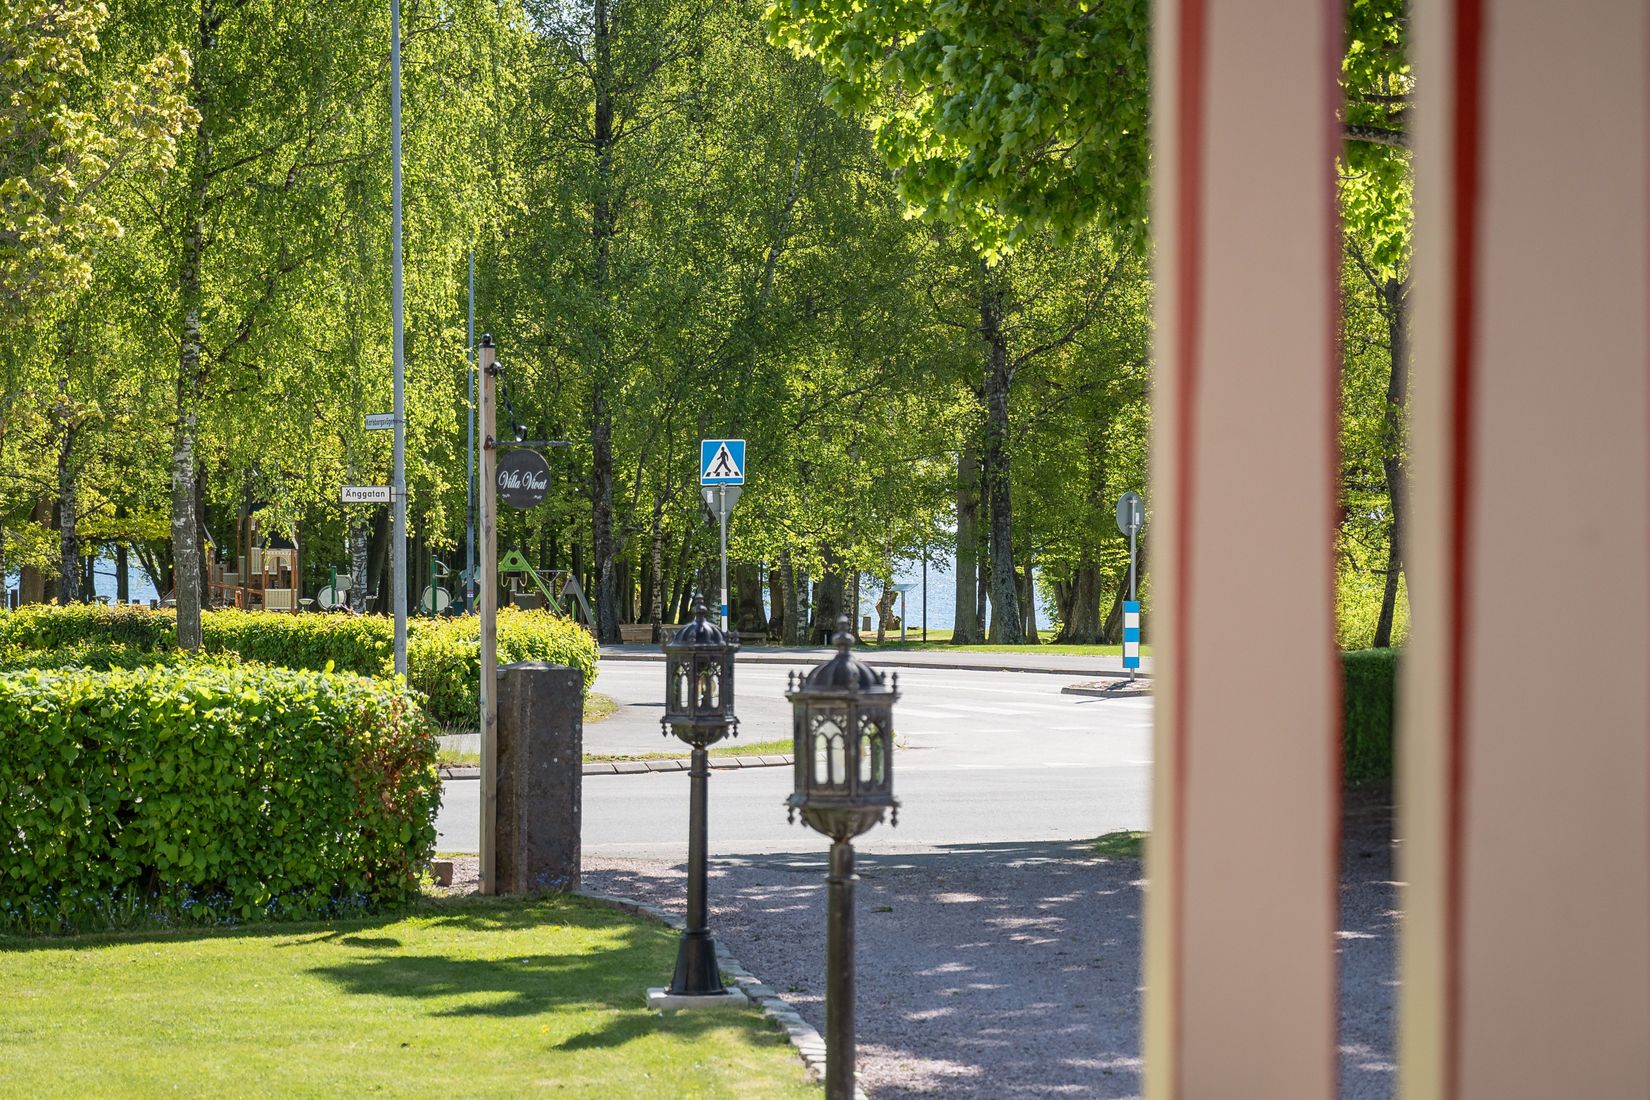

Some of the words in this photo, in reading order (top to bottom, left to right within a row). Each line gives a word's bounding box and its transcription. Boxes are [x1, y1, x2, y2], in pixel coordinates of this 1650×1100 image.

[498, 469, 520, 490] Villa
[521, 470, 548, 490] Vivat
[345, 488, 386, 499] Änggatan
